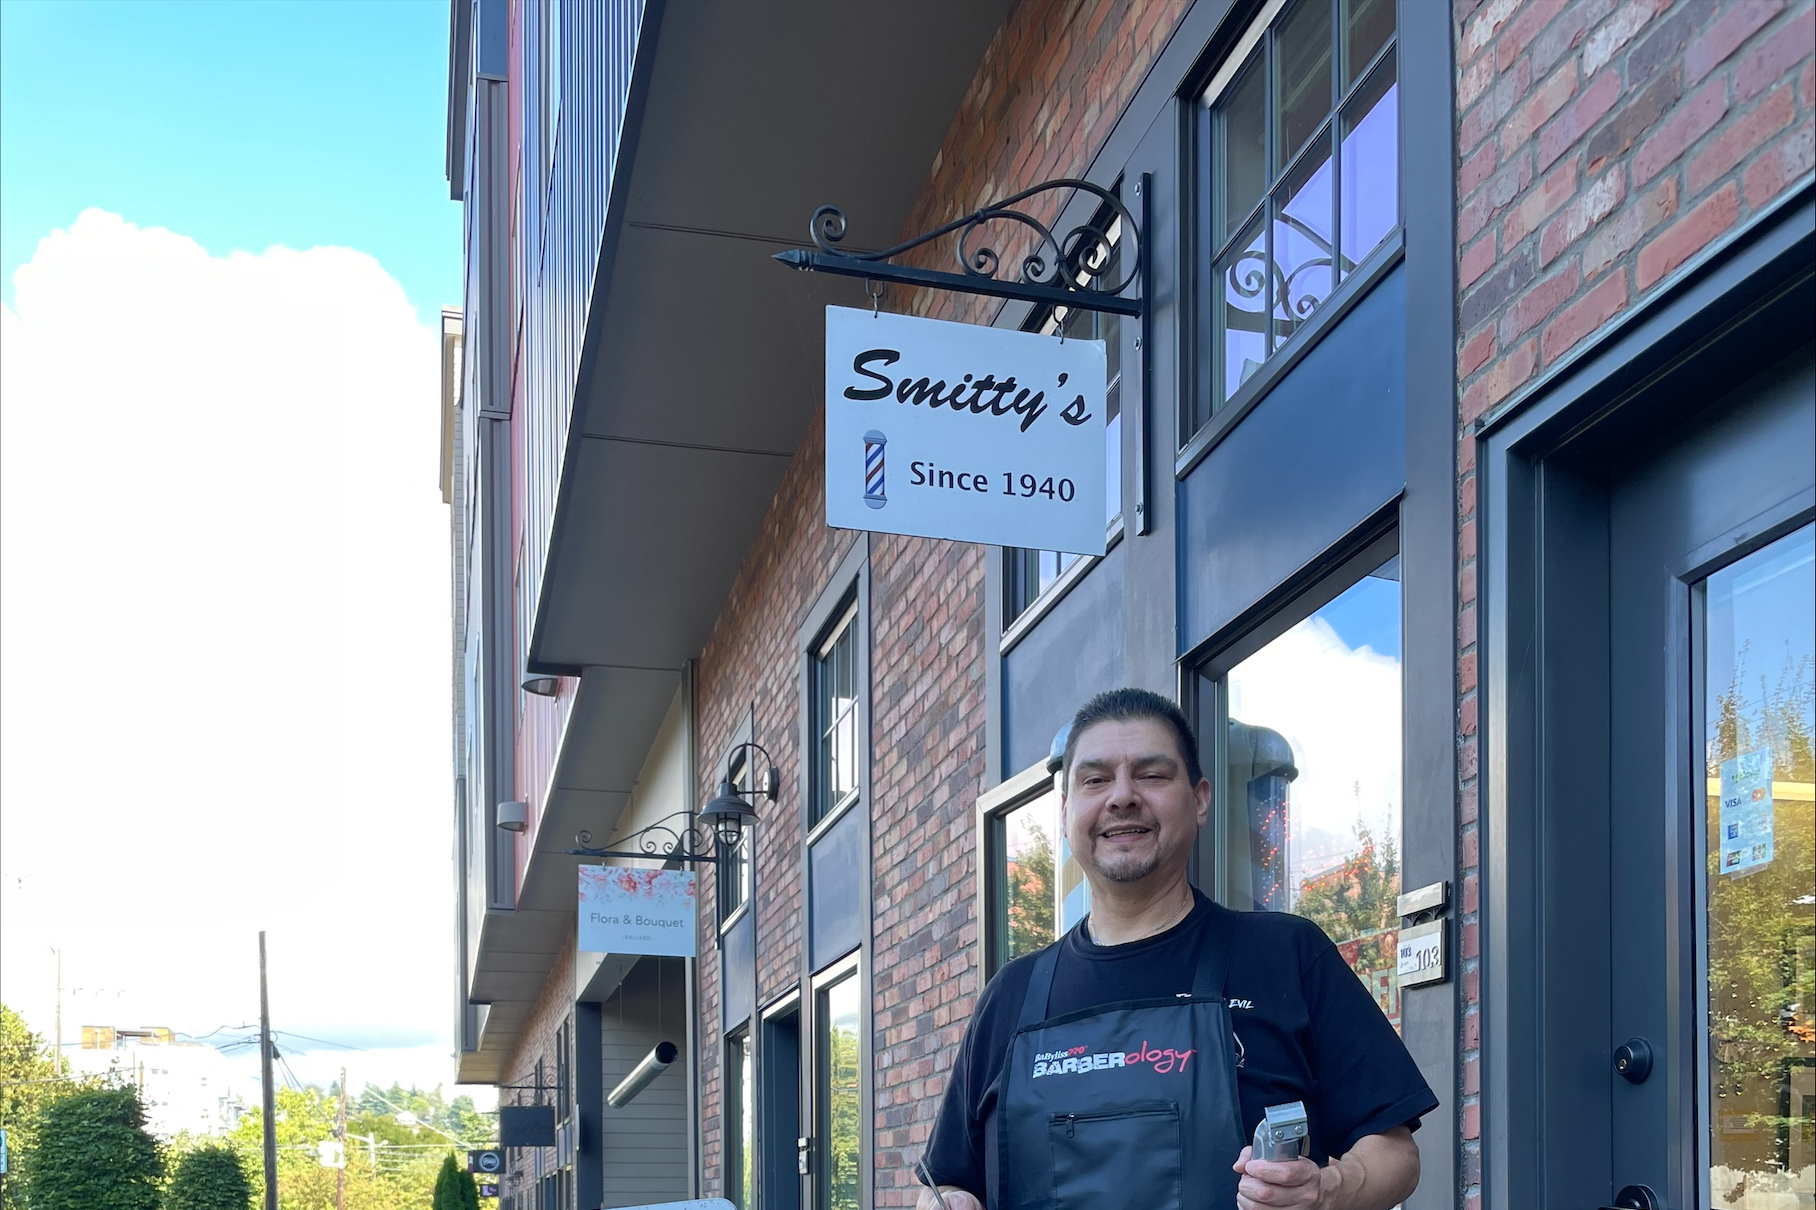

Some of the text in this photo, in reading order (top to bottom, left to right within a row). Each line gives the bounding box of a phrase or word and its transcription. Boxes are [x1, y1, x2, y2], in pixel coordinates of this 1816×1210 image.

[843, 349, 1092, 432] Smitty's
[910, 461, 1075, 502] Since 1940
[1725, 797, 1742, 808] VISA
[590, 912, 684, 929] Flora & Bouquet
